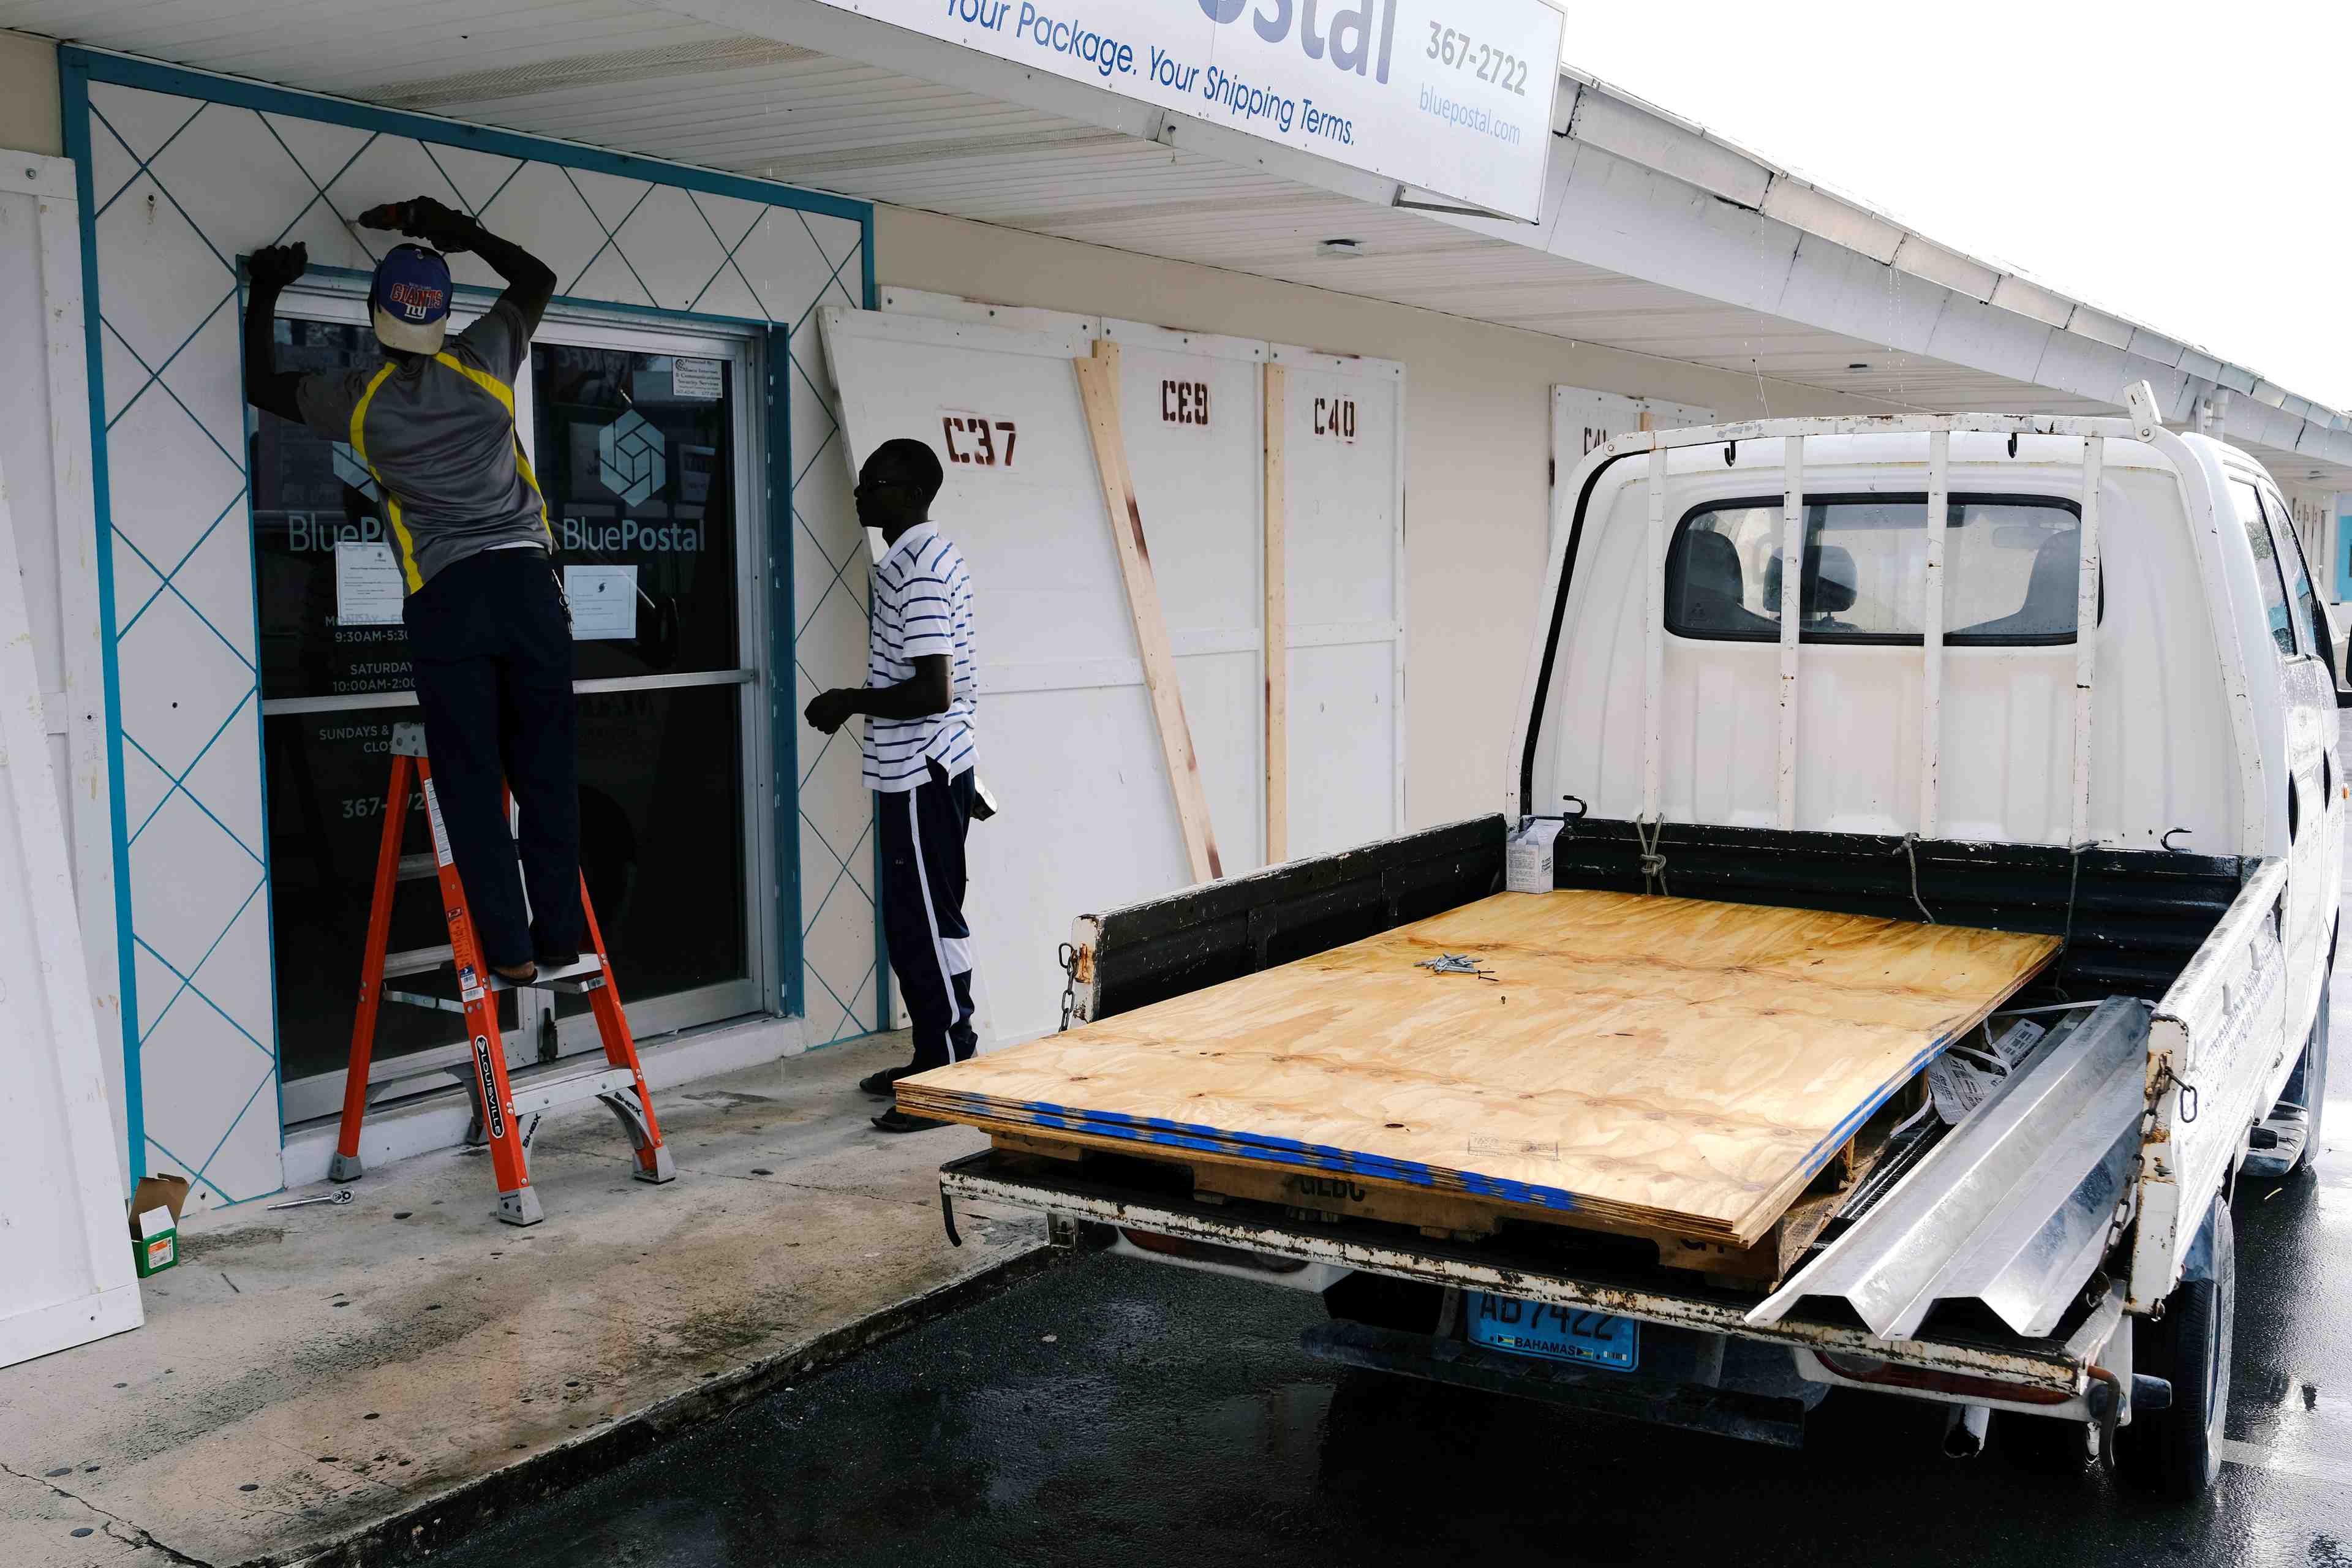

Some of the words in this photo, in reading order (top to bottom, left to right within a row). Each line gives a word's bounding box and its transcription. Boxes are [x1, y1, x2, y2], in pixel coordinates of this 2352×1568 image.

[1016, 2, 1137, 75] Package.
[1150, 46, 1199, 92] Your
[1204, 66, 1294, 132] Shipping
[1299, 99, 1355, 145] Terms.
[1427, 20, 1528, 96] 367-2722
[1419, 83, 1520, 145] bluepostal.com
[390, 282, 442, 309] GIANTS
[1314, 398, 1355, 437] C40
[943, 417, 1016, 466] C37
[289, 513, 390, 552] BlueP
[564, 516, 704, 551] BluePostal
[350, 662, 413, 675] SATURDAY
[318, 726, 377, 741] SUNDAYS
[381, 725, 389, 736] &
[481, 1054, 501, 1135] LOUISVILLE
[1515, 1336, 1576, 1355] BAHAMAS
